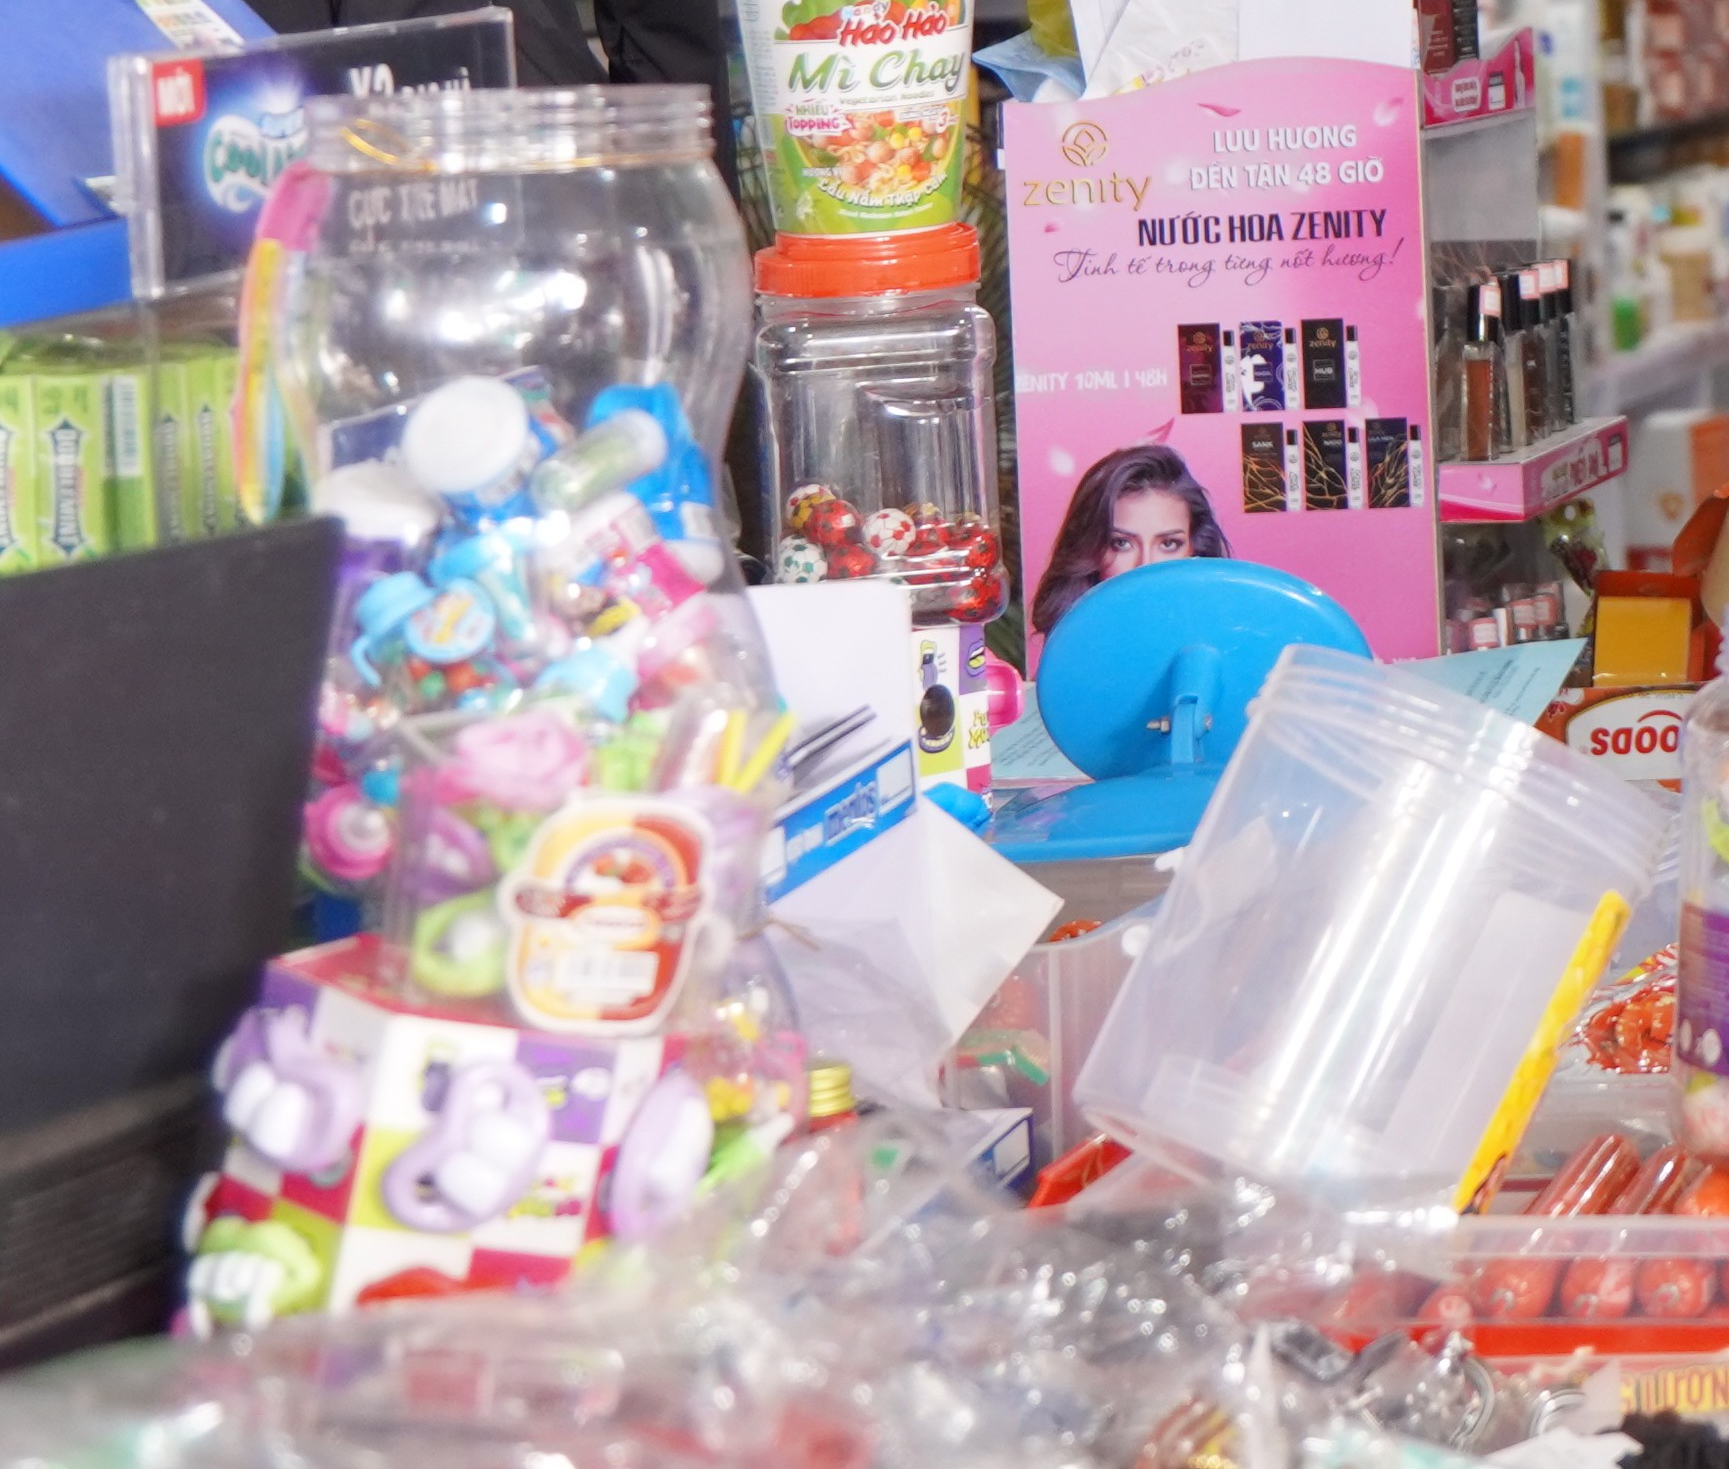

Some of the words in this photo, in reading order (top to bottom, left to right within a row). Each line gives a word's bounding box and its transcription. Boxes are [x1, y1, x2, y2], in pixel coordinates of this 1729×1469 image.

[839, 12, 898, 47] Hảo
[901, 1, 949, 41] Hảo
[786, 50, 858, 93] Mì
[868, 47, 966, 96] Chay
[1023, 172, 1152, 211] zenity
[1297, 161, 1332, 186] 48
[1138, 211, 1221, 247] NƯỚC
[1228, 212, 1285, 243] HOA
[1290, 208, 1388, 241] ZENITY
[1053, 248, 1119, 283] Tinh
[1127, 253, 1152, 275] tế
[1155, 256, 1217, 289] trong
[1074, 369, 1119, 391] 10ML
[1135, 367, 1169, 387] 48H
